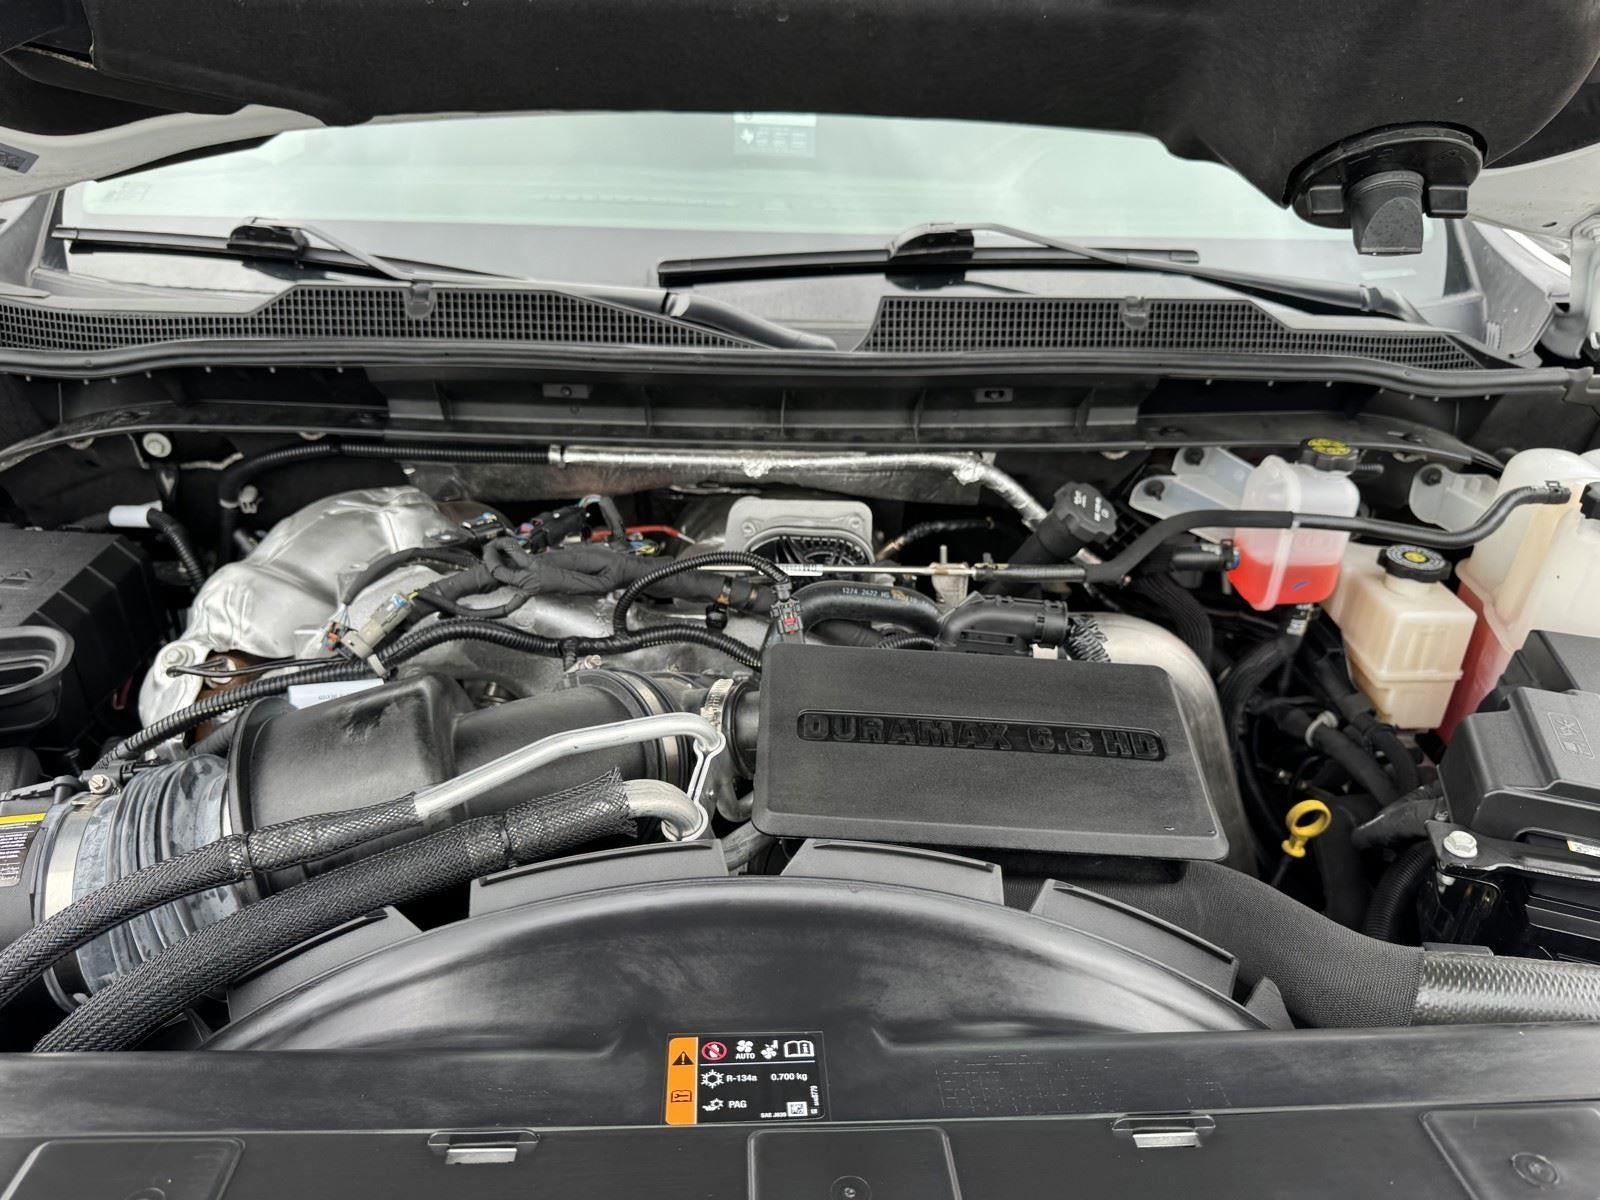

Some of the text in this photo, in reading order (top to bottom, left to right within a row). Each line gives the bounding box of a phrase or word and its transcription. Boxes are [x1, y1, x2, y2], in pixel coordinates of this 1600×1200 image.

[803, 714, 1161, 759] DURAMAX 6.6 HD
[726, 1072, 808, 1083] R-134a 0.700 kg
[728, 1100, 747, 1108] PAG
